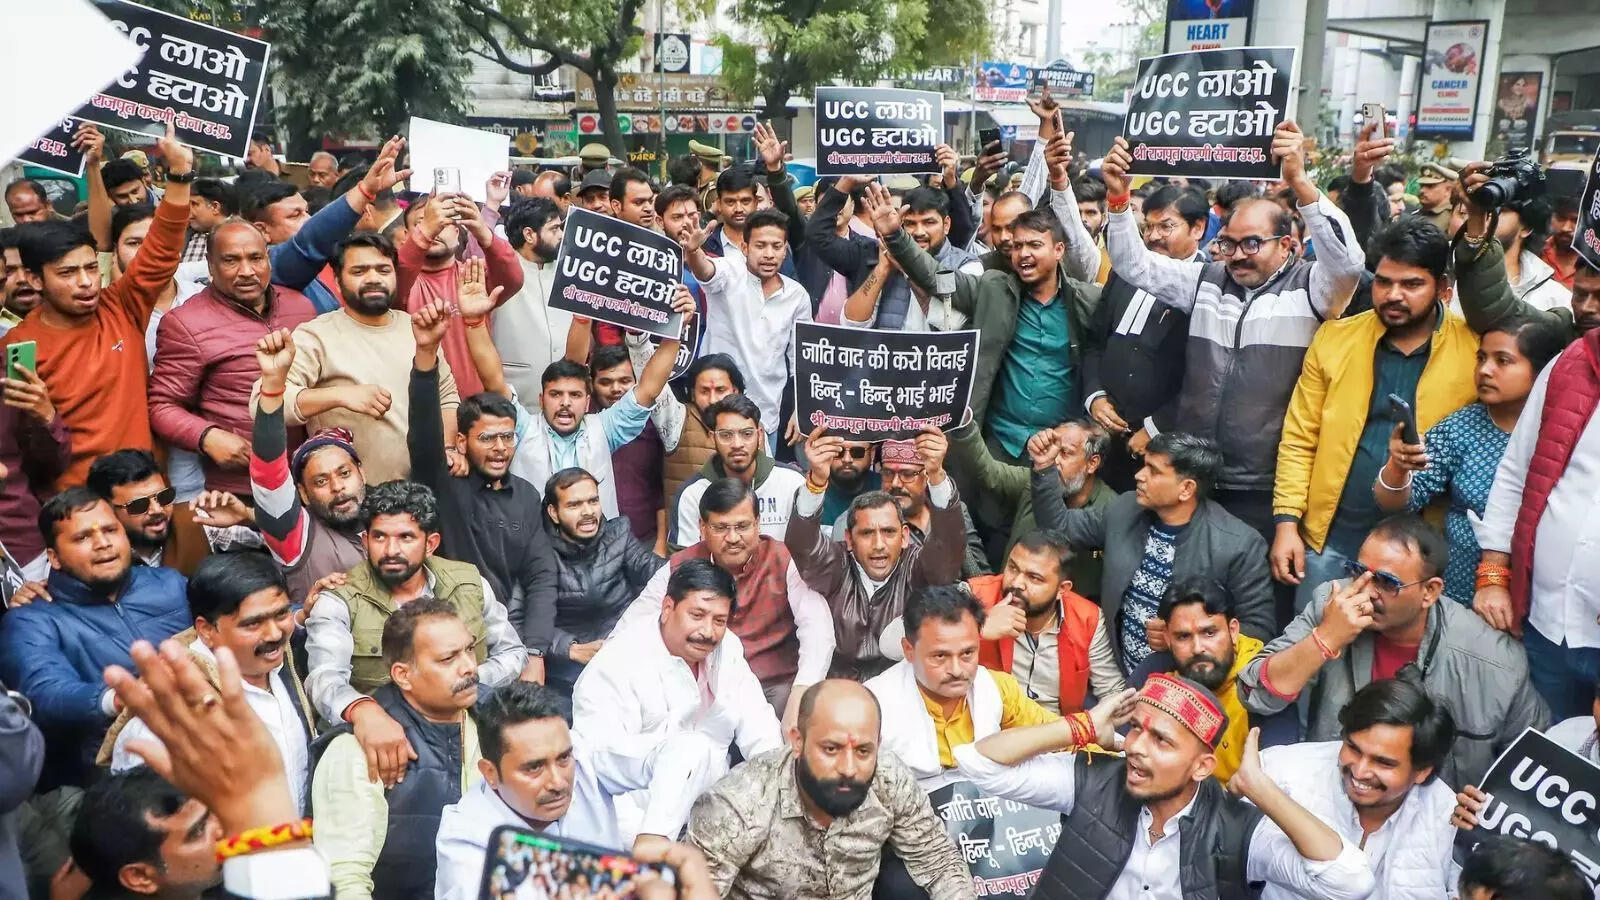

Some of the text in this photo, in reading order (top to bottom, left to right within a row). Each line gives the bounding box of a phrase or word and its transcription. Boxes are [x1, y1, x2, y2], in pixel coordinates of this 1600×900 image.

[1187, 24, 1229, 40] HEART
[160, 33, 250, 82] लाओ
[912, 68, 952, 81] WEAR
[1141, 60, 1277, 99] UCC लाओ
[1432, 80, 1468, 89] CANCER
[147, 69, 249, 119] हटाओ
[825, 98, 932, 120] UCC लाओ
[137, 103, 176, 124] करणी
[176, 111, 203, 133] सेना
[1129, 110, 1181, 136] UGC
[1188, 101, 1278, 137] हटाओ
[821, 125, 937, 147] UGC हटाओ
[827, 152, 840, 165] श्री
[840, 153, 868, 168] राजपूत
[869, 152, 892, 165] करणी
[892, 152, 911, 164] सेना
[1134, 143, 1148, 161] श्री
[1148, 147, 1181, 166] राजपूत
[1182, 144, 1212, 162] करणी
[1213, 144, 1238, 162] सेना
[574, 226, 679, 276] UCC लाओ
[562, 255, 678, 306] UGC हटाओ
[562, 284, 576, 301] श्री
[576, 289, 605, 310] राजपूत
[605, 297, 631, 314] करणी
[630, 302, 650, 319] सेना
[802, 338, 969, 372] जाति वाद की करो विदाई
[809, 373, 845, 410] हिन्दू
[859, 379, 896, 412] हिन्दू
[896, 380, 927, 409] भाई
[929, 378, 958, 405] भाई
[810, 410, 826, 427] श्री
[827, 415, 866, 434] राजपूत
[866, 416, 901, 432] करणी
[1510, 756, 1596, 825] UCC
[937, 794, 976, 822] जाति
[973, 795, 1003, 821] वाद
[958, 832, 1000, 869] हिन्दू
[1005, 826, 1051, 858] हिन्दू
[987, 873, 1030, 897] राजपूत
